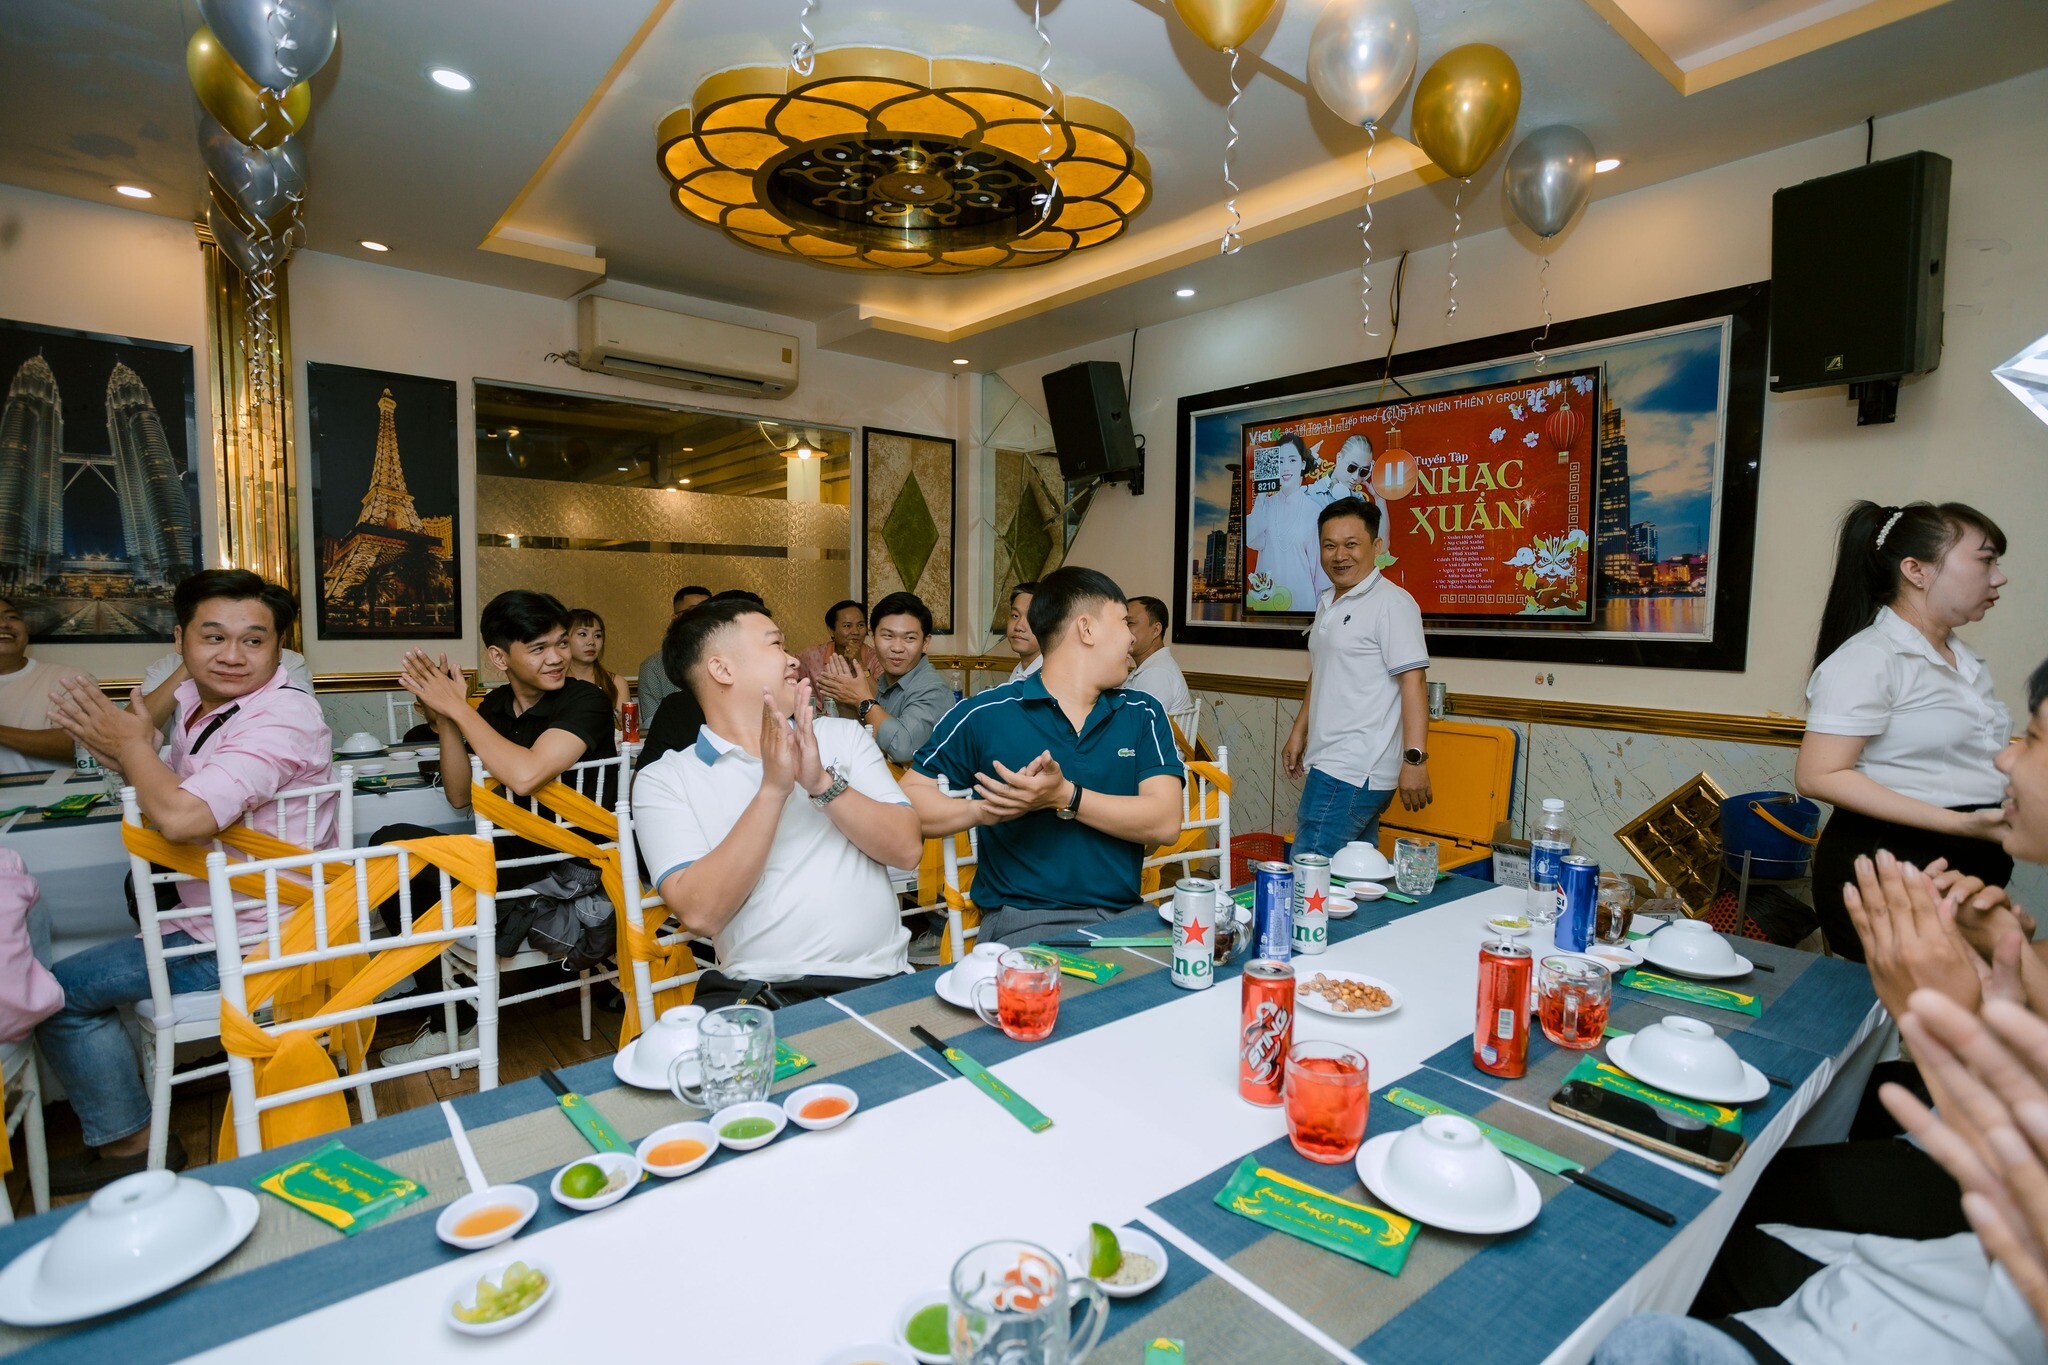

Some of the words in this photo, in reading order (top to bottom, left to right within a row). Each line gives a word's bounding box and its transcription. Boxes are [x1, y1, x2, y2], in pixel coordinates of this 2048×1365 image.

[1428, 401, 1451, 414] NIÊN
[1454, 396, 1484, 410] THIÊN
[1486, 394, 1494, 405] Ý
[1496, 389, 1531, 403] GROUP
[1448, 451, 1469, 464] Tập
[1257, 481, 1277, 491] 8210
[1409, 497, 1524, 544] XUÂN
[1295, 881, 1305, 916] SILVER
[1174, 908, 1183, 946] SILVER
